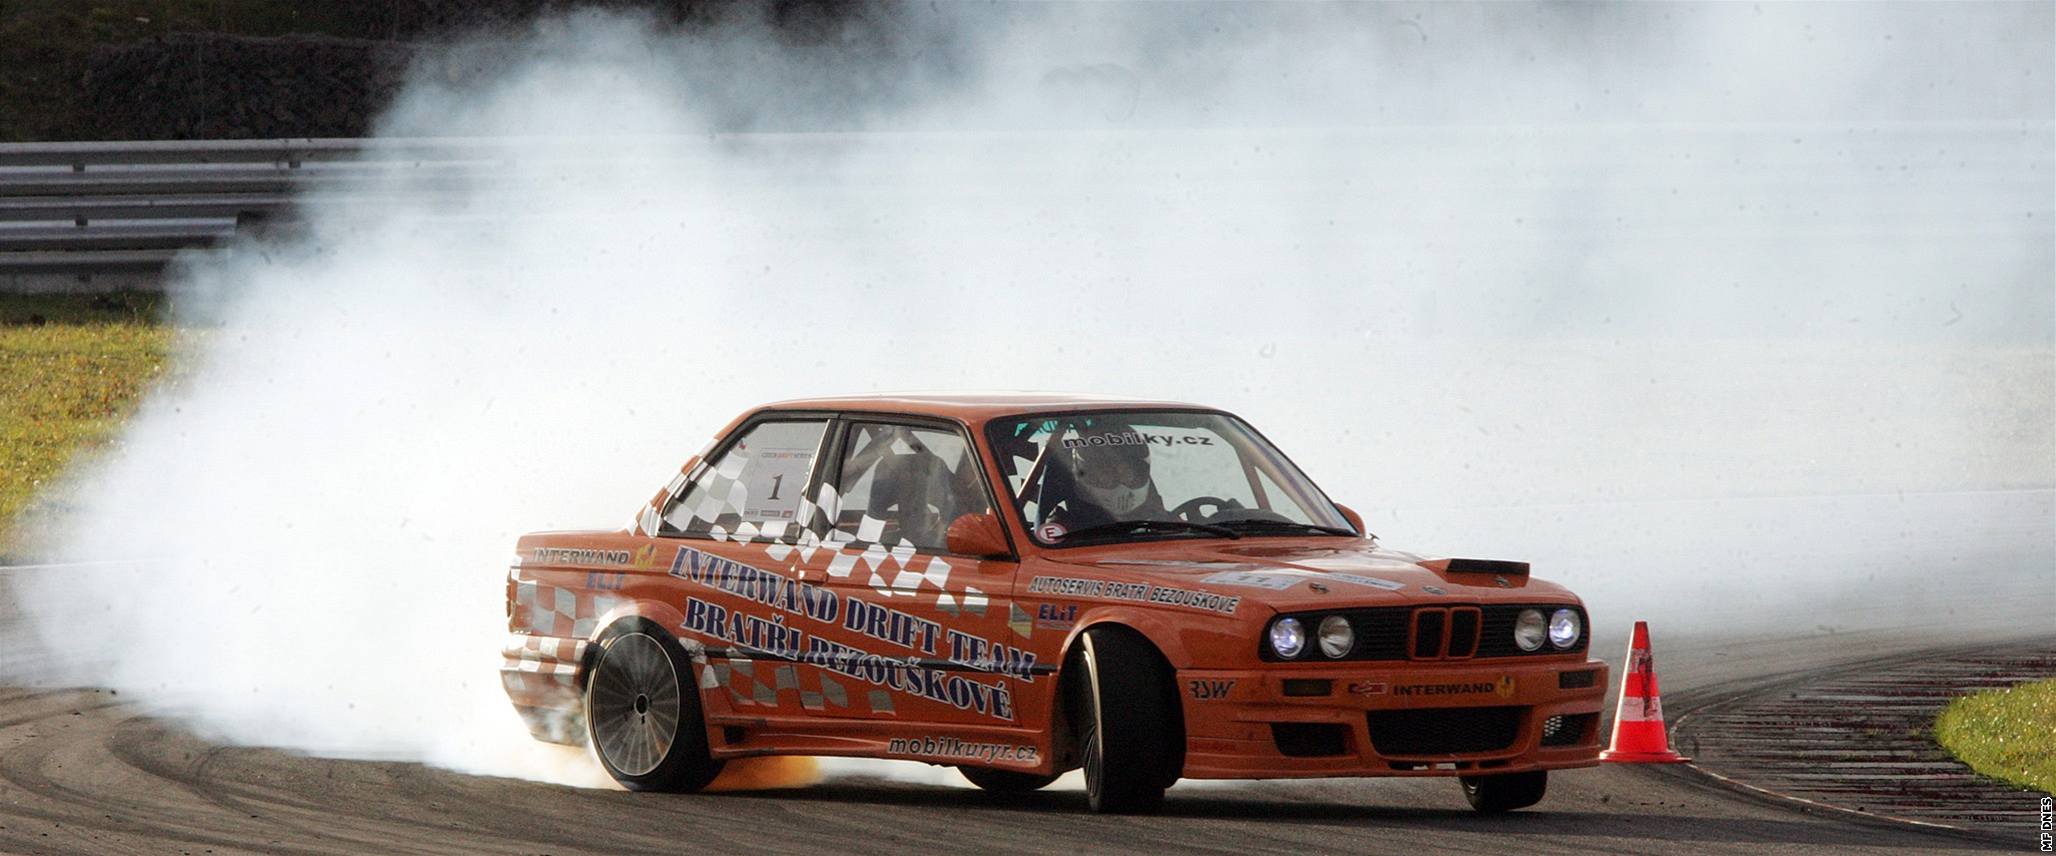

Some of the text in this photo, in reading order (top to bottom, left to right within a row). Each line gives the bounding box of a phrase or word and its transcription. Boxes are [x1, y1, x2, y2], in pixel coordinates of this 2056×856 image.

[1063, 432, 1214, 448] mobilky.cz
[768, 473, 783, 500] 1
[534, 547, 630, 565] INTERWAND
[1028, 576, 1104, 598] AUTOSERVIS
[669, 545, 1036, 683] INTERWAND DRIFT TEAM
[803, 634, 1014, 721] BEZOUŠKOVÉ
[1393, 682, 1495, 695] INTERWAND
[888, 736, 1039, 763] mobilkuryr.cz
